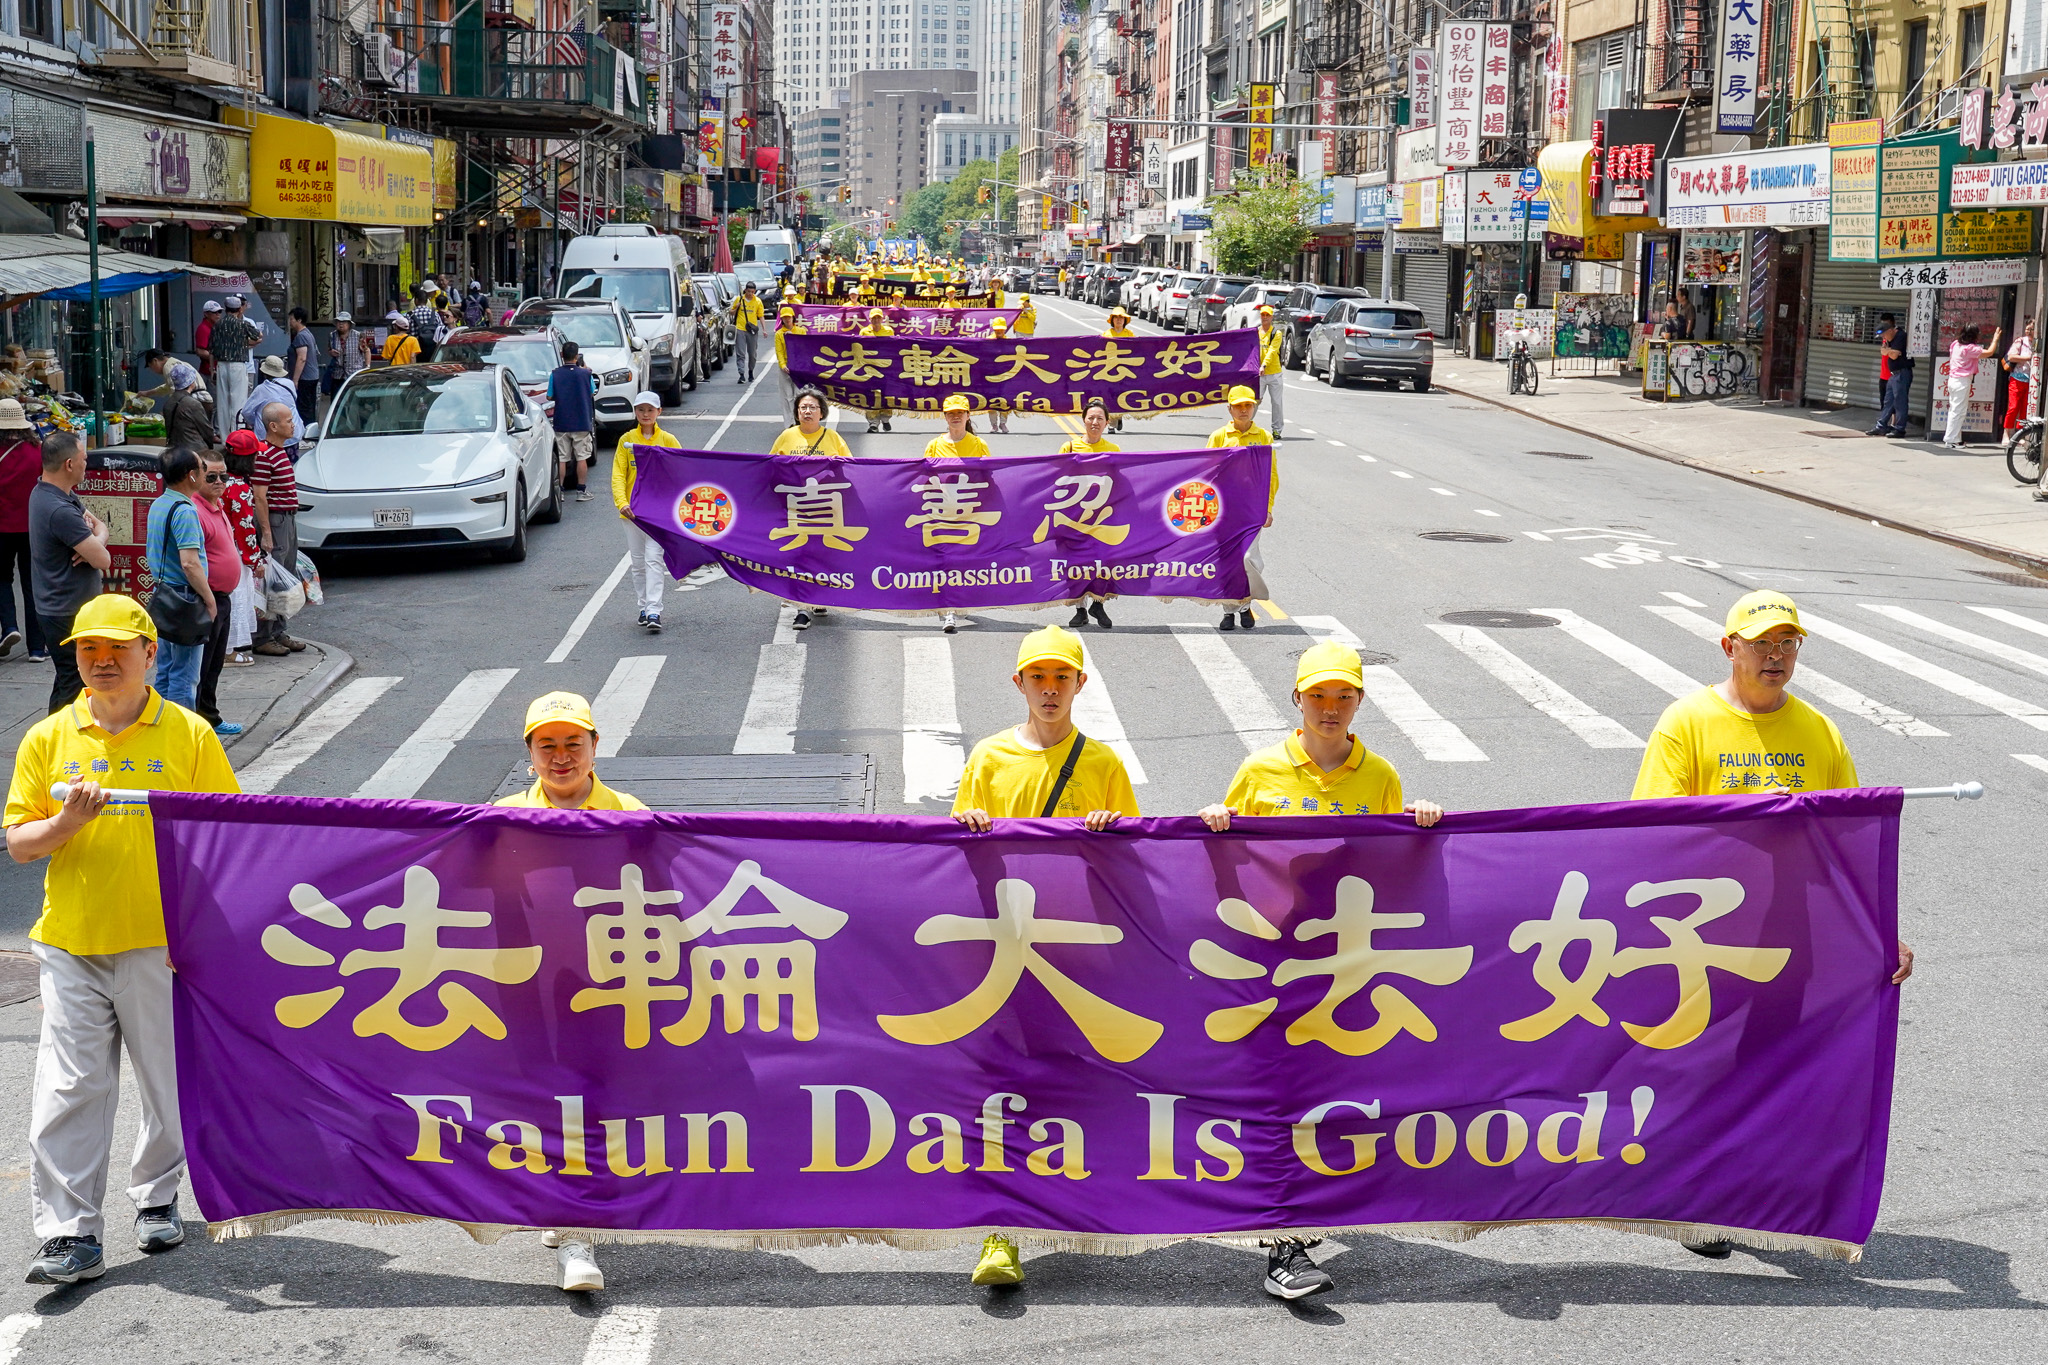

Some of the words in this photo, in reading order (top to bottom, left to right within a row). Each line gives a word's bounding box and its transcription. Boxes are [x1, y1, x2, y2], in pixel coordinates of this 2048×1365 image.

[1760, 164, 1801, 189] PHARMACY
[1802, 162, 1817, 187] INC
[1954, 168, 1990, 185] 212-274-8659
[1991, 166, 2015, 187] JUFU
[275, 178, 334, 192] 福州小吃店
[279, 192, 332, 204] 646-326-8810
[1952, 188, 1989, 203] 212-925-1637
[813, 340, 1234, 388] 法輪大法好
[768, 473, 1131, 552] 真善忍
[871, 562, 1033, 594] Compassion
[1050, 558, 1217, 582] Forbearance
[63, 758, 164, 775] 法輪大法
[1719, 753, 1761, 767] FALUN
[1764, 752, 1805, 768] GONG
[1722, 771, 1805, 789] 法輪大法
[1275, 797, 1370, 815] 法輪大法
[261, 859, 1792, 1063] 法輪大法好
[392, 1092, 755, 1178] Falun
[800, 1083, 1092, 1181] Dafa
[1137, 1092, 1245, 1183] Is
[1291, 1085, 1656, 1177] Good!
